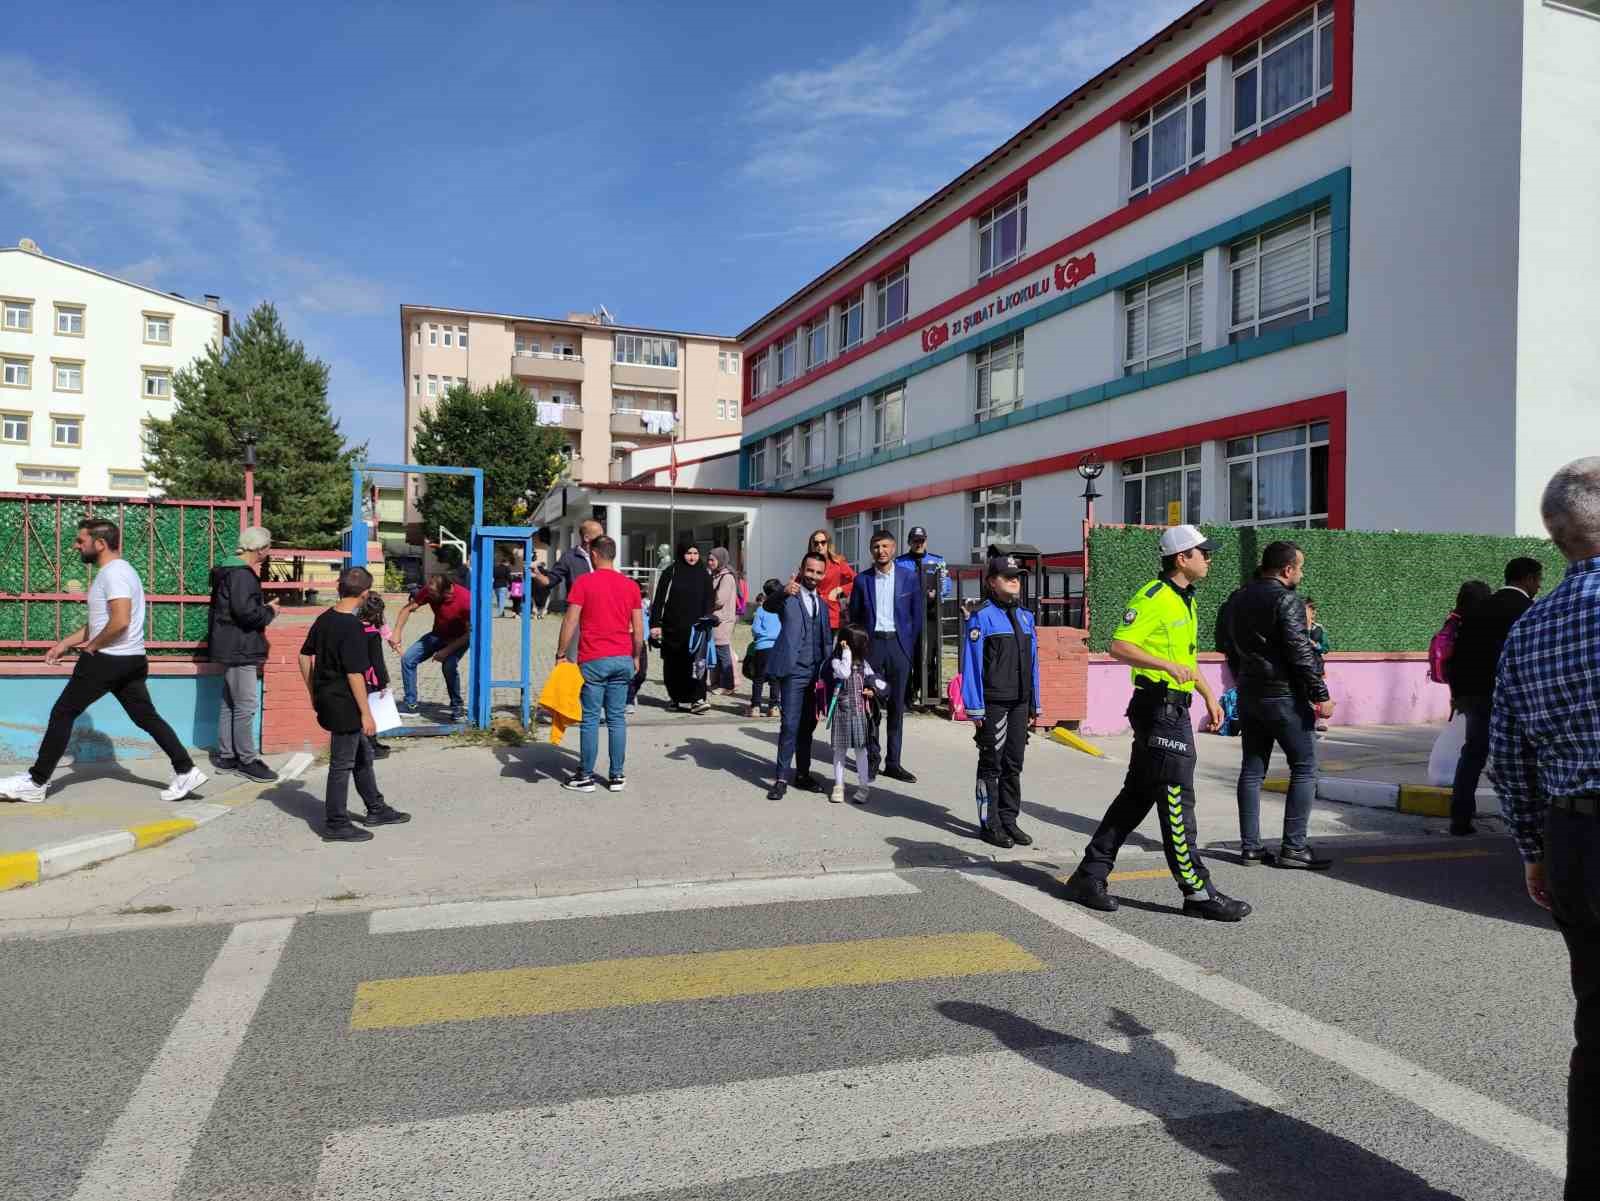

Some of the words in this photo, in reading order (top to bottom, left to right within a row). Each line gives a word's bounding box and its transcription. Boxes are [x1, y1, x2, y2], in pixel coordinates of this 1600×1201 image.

[952, 321, 961, 336] 23
[963, 303, 995, 334] ŞUBAT
[997, 278, 1050, 314] İLKOKULU
